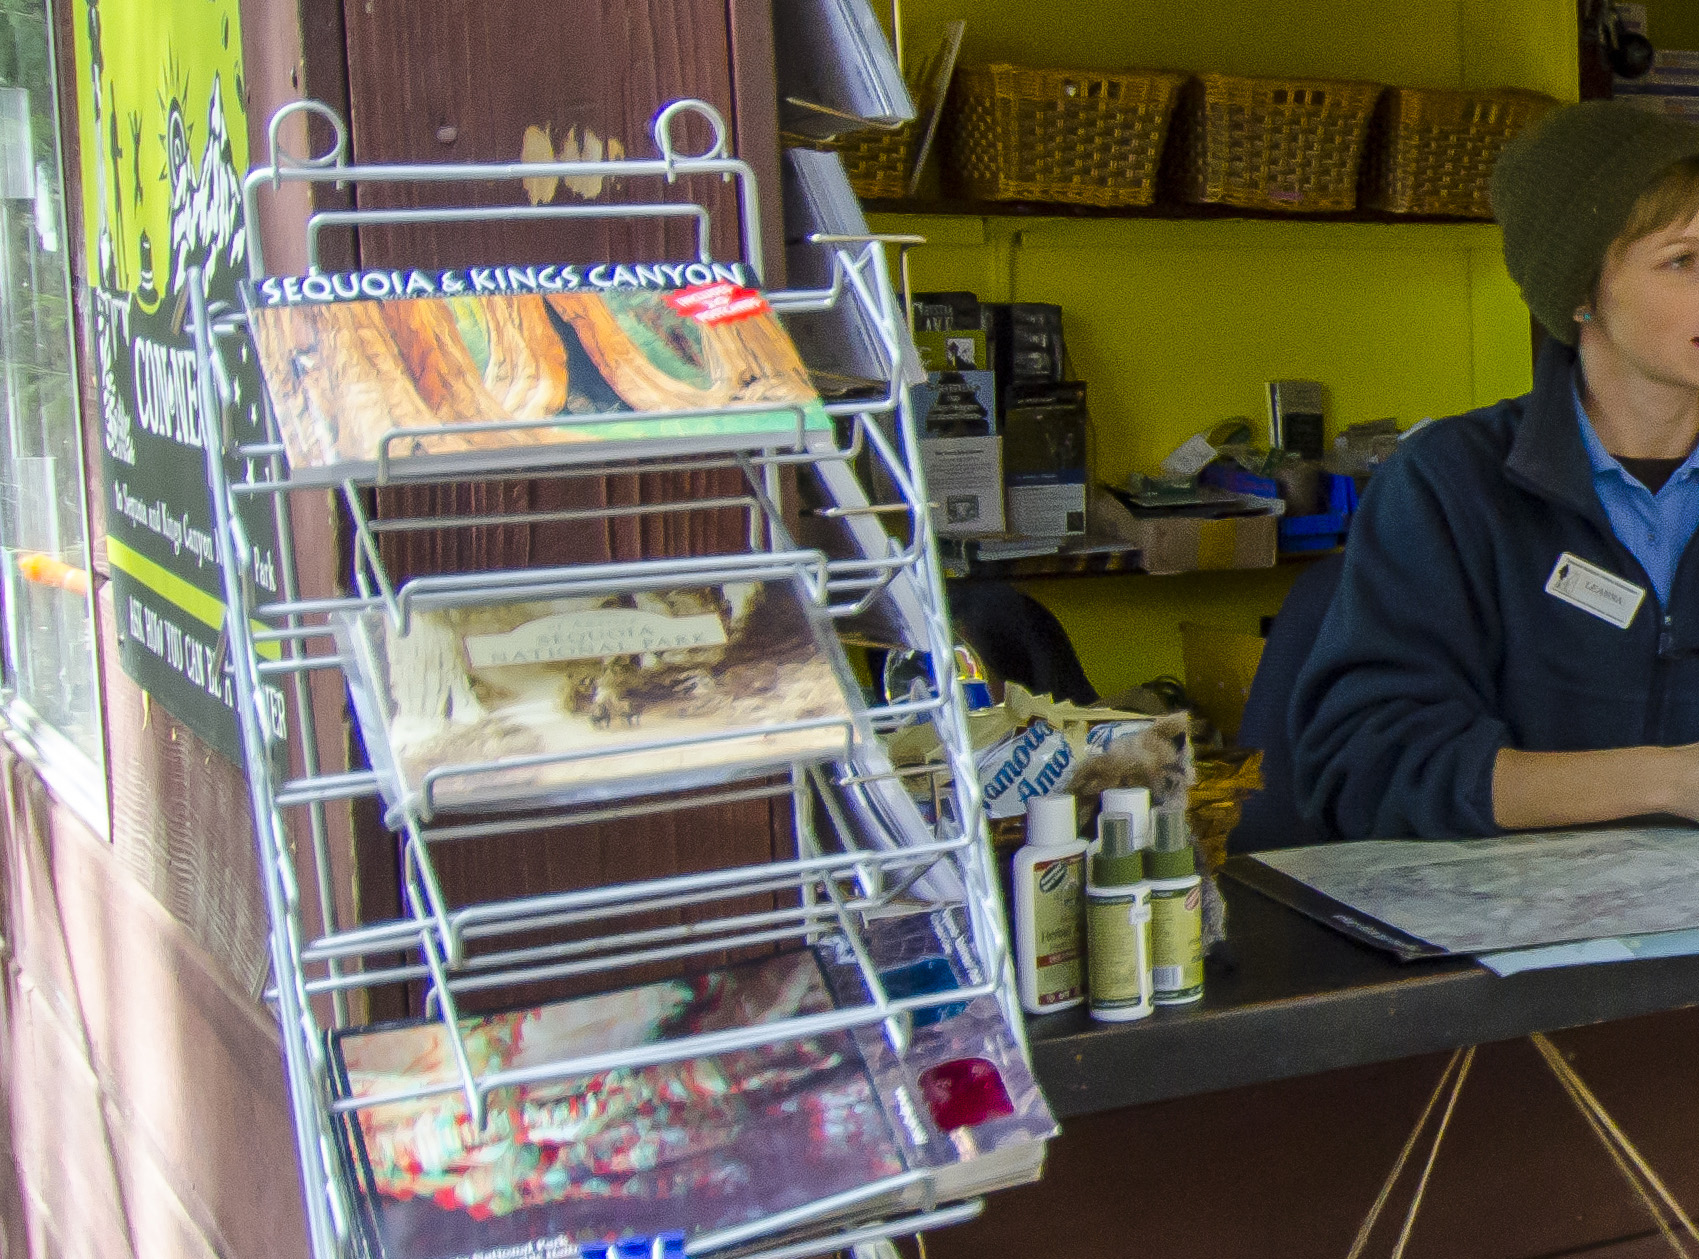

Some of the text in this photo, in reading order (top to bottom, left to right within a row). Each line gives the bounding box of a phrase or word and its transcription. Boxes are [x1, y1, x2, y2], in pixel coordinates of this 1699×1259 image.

[261, 262, 747, 304] SEQUOIA & KINGS CANYON
[182, 511, 214, 569] Canyon
[253, 546, 278, 593] Park
[184, 633, 206, 688] CAN
